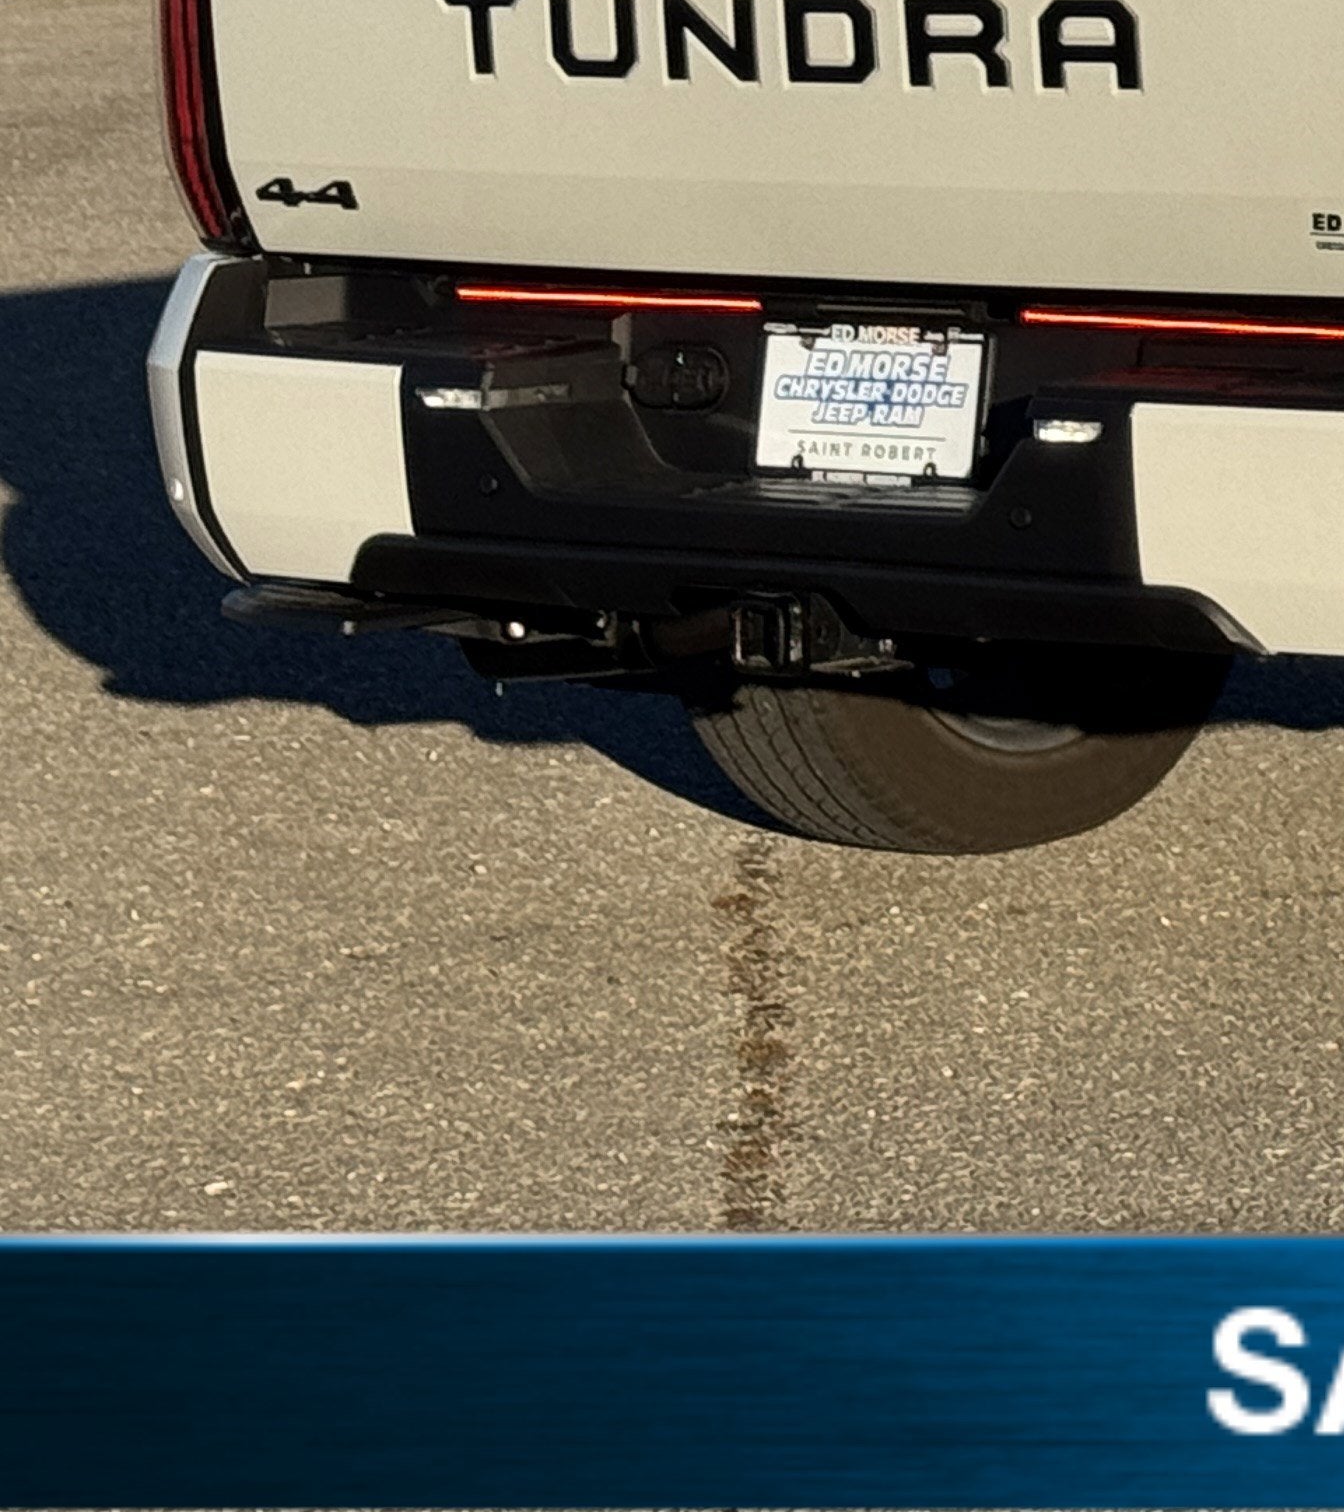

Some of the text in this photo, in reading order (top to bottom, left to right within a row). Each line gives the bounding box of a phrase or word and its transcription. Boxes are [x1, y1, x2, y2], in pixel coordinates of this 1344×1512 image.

[1312, 213, 1341, 231] ED
[831, 324, 920, 344] ED MORSE
[808, 351, 950, 384] ED MORSE
[812, 403, 923, 426] JEEP RAM
[797, 440, 936, 461] SAINT ROBERT
